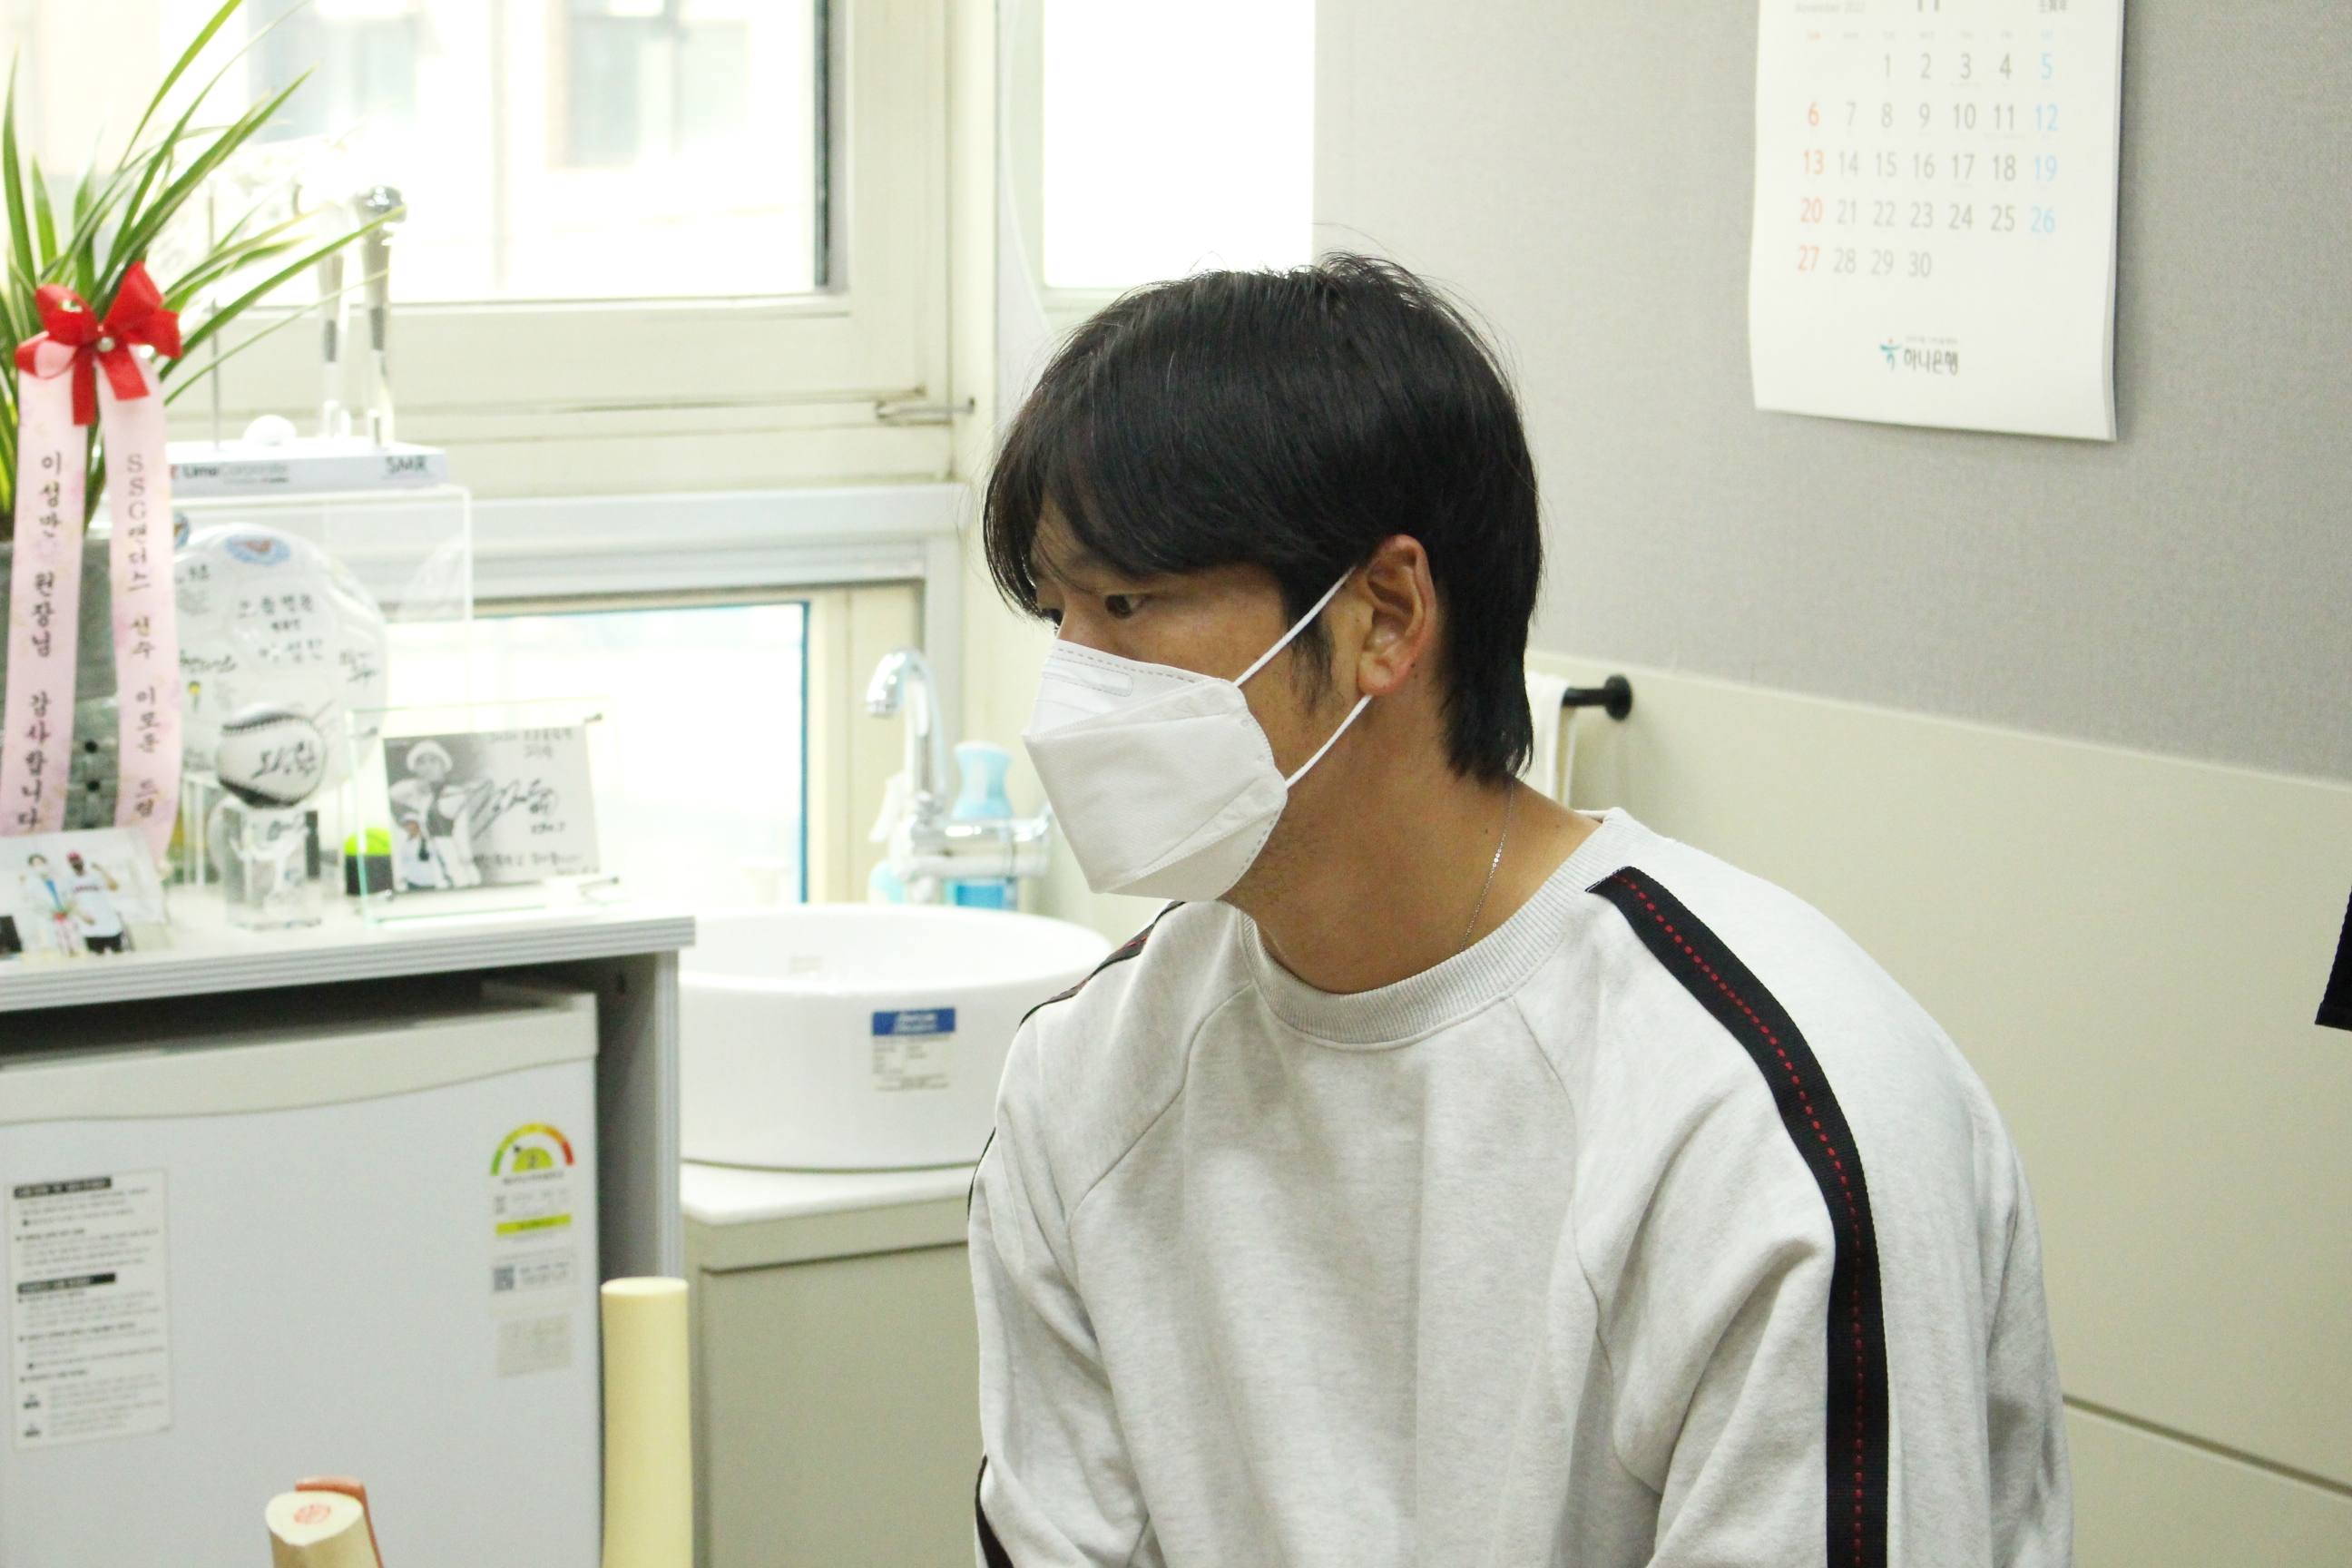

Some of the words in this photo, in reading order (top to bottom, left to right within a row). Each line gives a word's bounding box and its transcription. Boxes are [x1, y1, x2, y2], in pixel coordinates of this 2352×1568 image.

[1884, 53, 1891, 79] 1
[1921, 53, 1932, 79] 2
[1960, 53, 1973, 80] 3
[1999, 53, 2013, 79] 4
[2042, 53, 2053, 80] 5
[1808, 101, 1820, 128] 6
[1846, 102, 1857, 127] 7
[1881, 102, 1894, 128] 8
[1919, 103, 1931, 128] 9
[1953, 103, 1977, 130] 10
[1994, 103, 2016, 130] 11
[2035, 103, 2059, 132] 12
[1803, 149, 1825, 176] 13
[1838, 151, 1859, 176] 14
[1876, 152, 1897, 177] 15
[1914, 152, 1936, 179] 16
[1952, 153, 1975, 180] 17
[1993, 154, 2017, 181] 18
[2034, 155, 2058, 181] 19
[1800, 197, 1824, 224] 20
[1838, 200, 1857, 225] 21
[1873, 201, 1896, 227] 22
[1910, 201, 1934, 228] 23
[1948, 203, 1974, 230] 24
[1991, 205, 2016, 232] 25
[2030, 206, 2055, 234] 26
[1798, 245, 1820, 271] 27
[1834, 248, 1857, 274] 28
[1871, 250, 1894, 276] 29
[1908, 251, 1932, 277] 30
